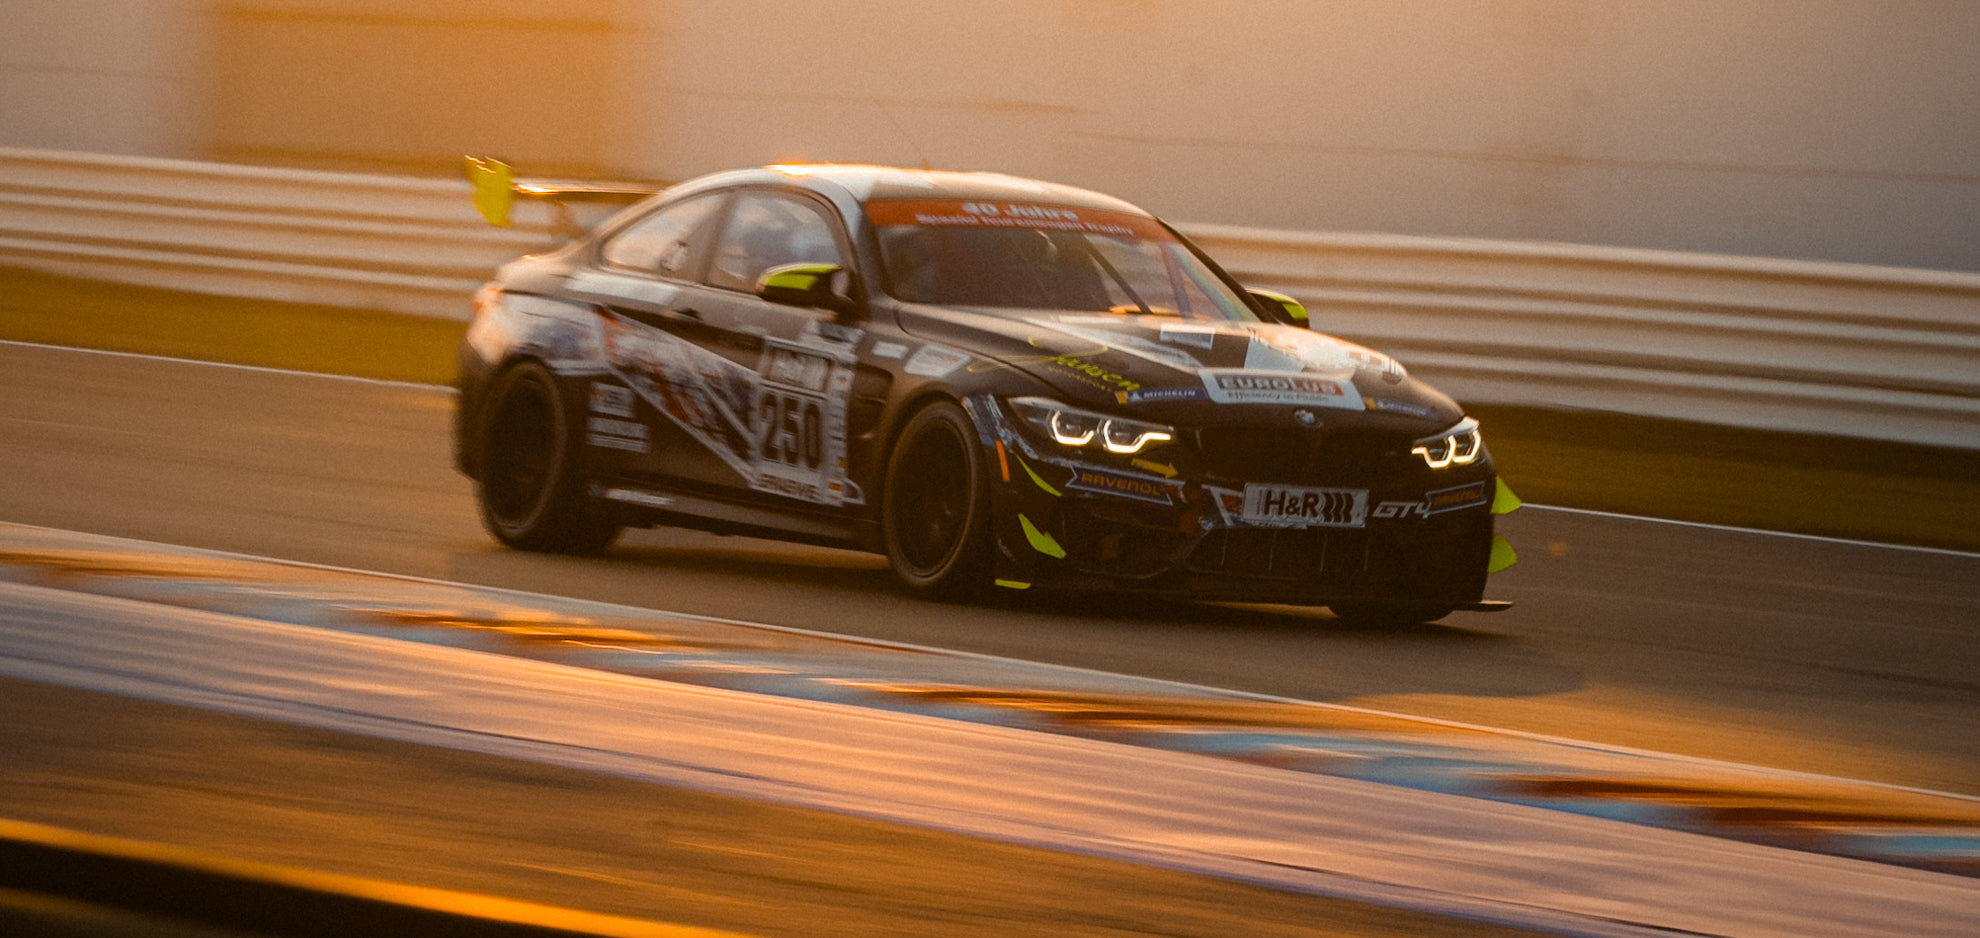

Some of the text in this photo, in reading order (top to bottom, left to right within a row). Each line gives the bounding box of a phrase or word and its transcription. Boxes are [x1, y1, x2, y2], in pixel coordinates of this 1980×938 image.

[963, 202, 1079, 221] 40 Jahre
[1144, 389, 1197, 399] MICHELIN
[1221, 376, 1337, 395] EUROLUB
[760, 392, 823, 473] 250
[1081, 472, 1161, 497] RAVENOL
[1264, 490, 1320, 518] H&R
[1372, 502, 1432, 519] GT4
